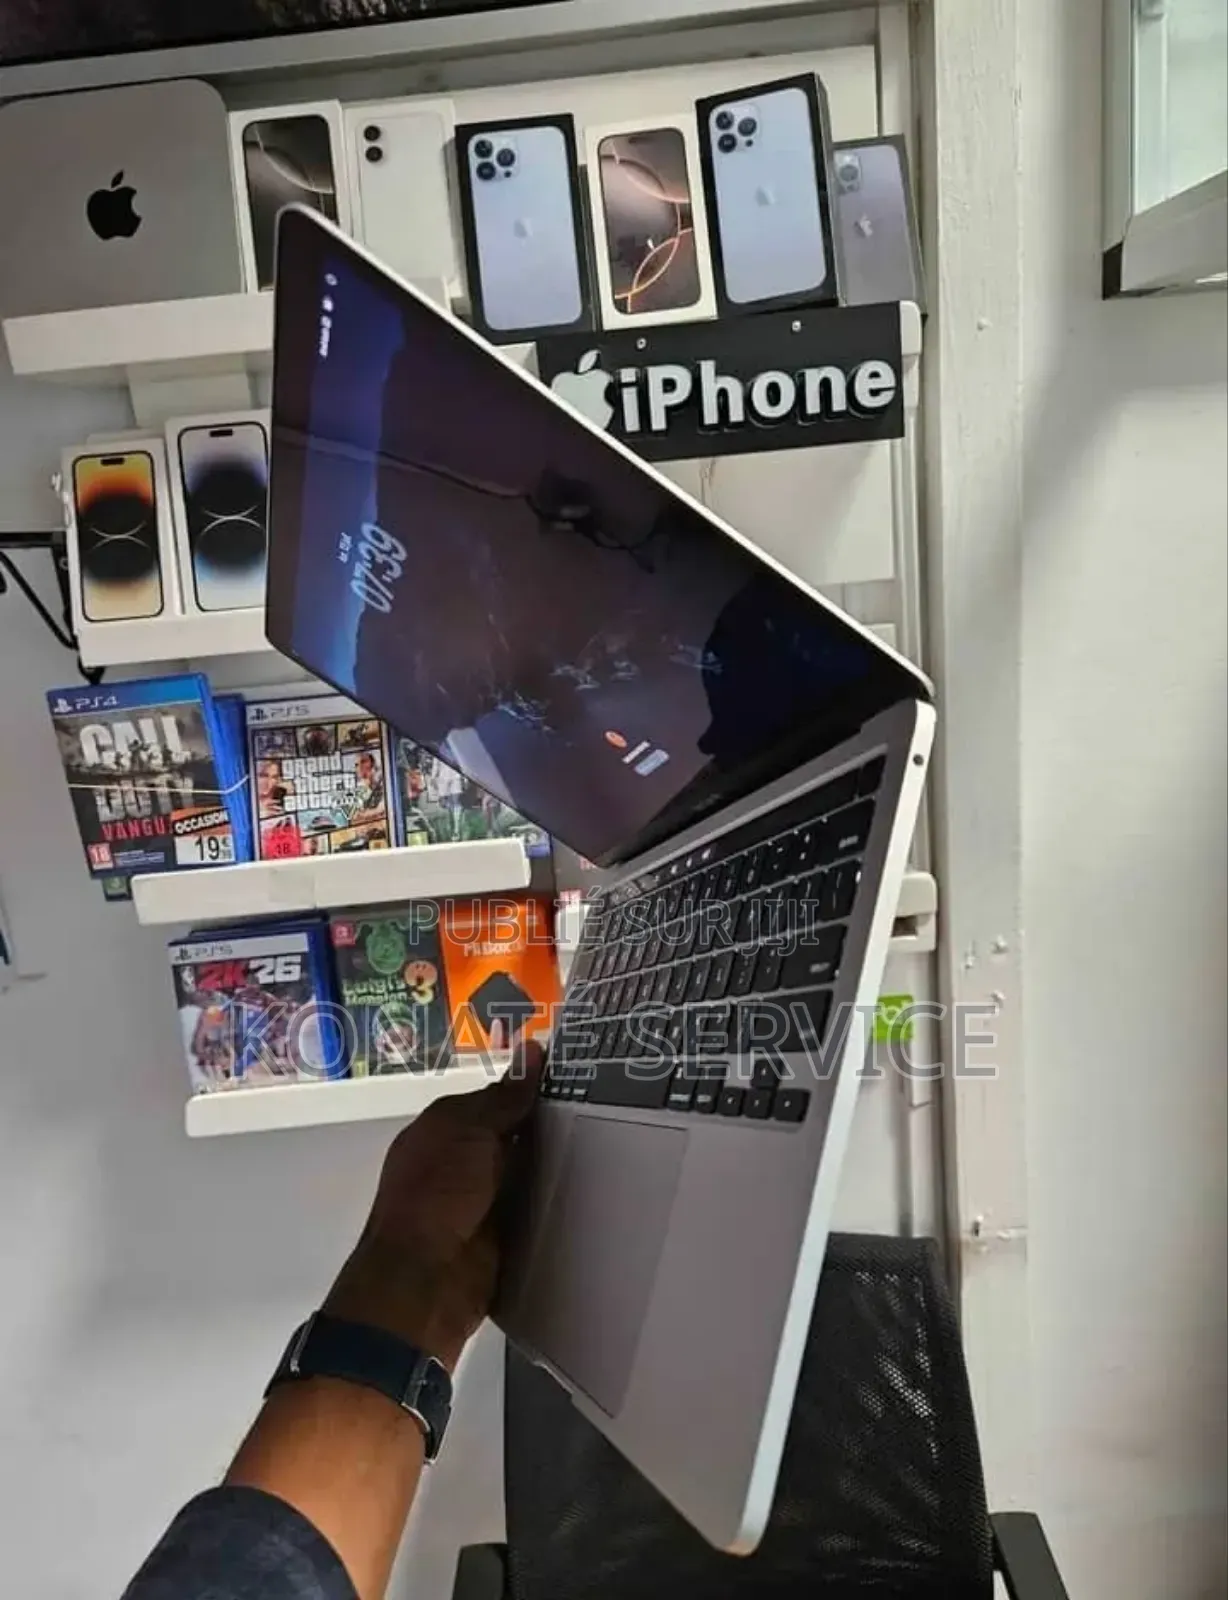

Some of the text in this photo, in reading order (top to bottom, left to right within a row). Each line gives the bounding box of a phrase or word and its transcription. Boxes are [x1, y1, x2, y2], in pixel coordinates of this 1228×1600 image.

[619, 360, 896, 432] iPhone
[350, 522, 407, 613] 07:39
[75, 695, 119, 709] PS4
[271, 704, 309, 717] PS5
[79, 715, 192, 772] CALL
[282, 751, 341, 779] grand
[294, 773, 356, 794] theft
[93, 774, 194, 822] DUTY
[283, 792, 332, 812] auto
[102, 817, 170, 841] VANGU
[175, 810, 228, 834] OCCASION
[195, 834, 219, 861] 19
[195, 944, 233, 956] PS5
[404, 960, 438, 1005] 3
